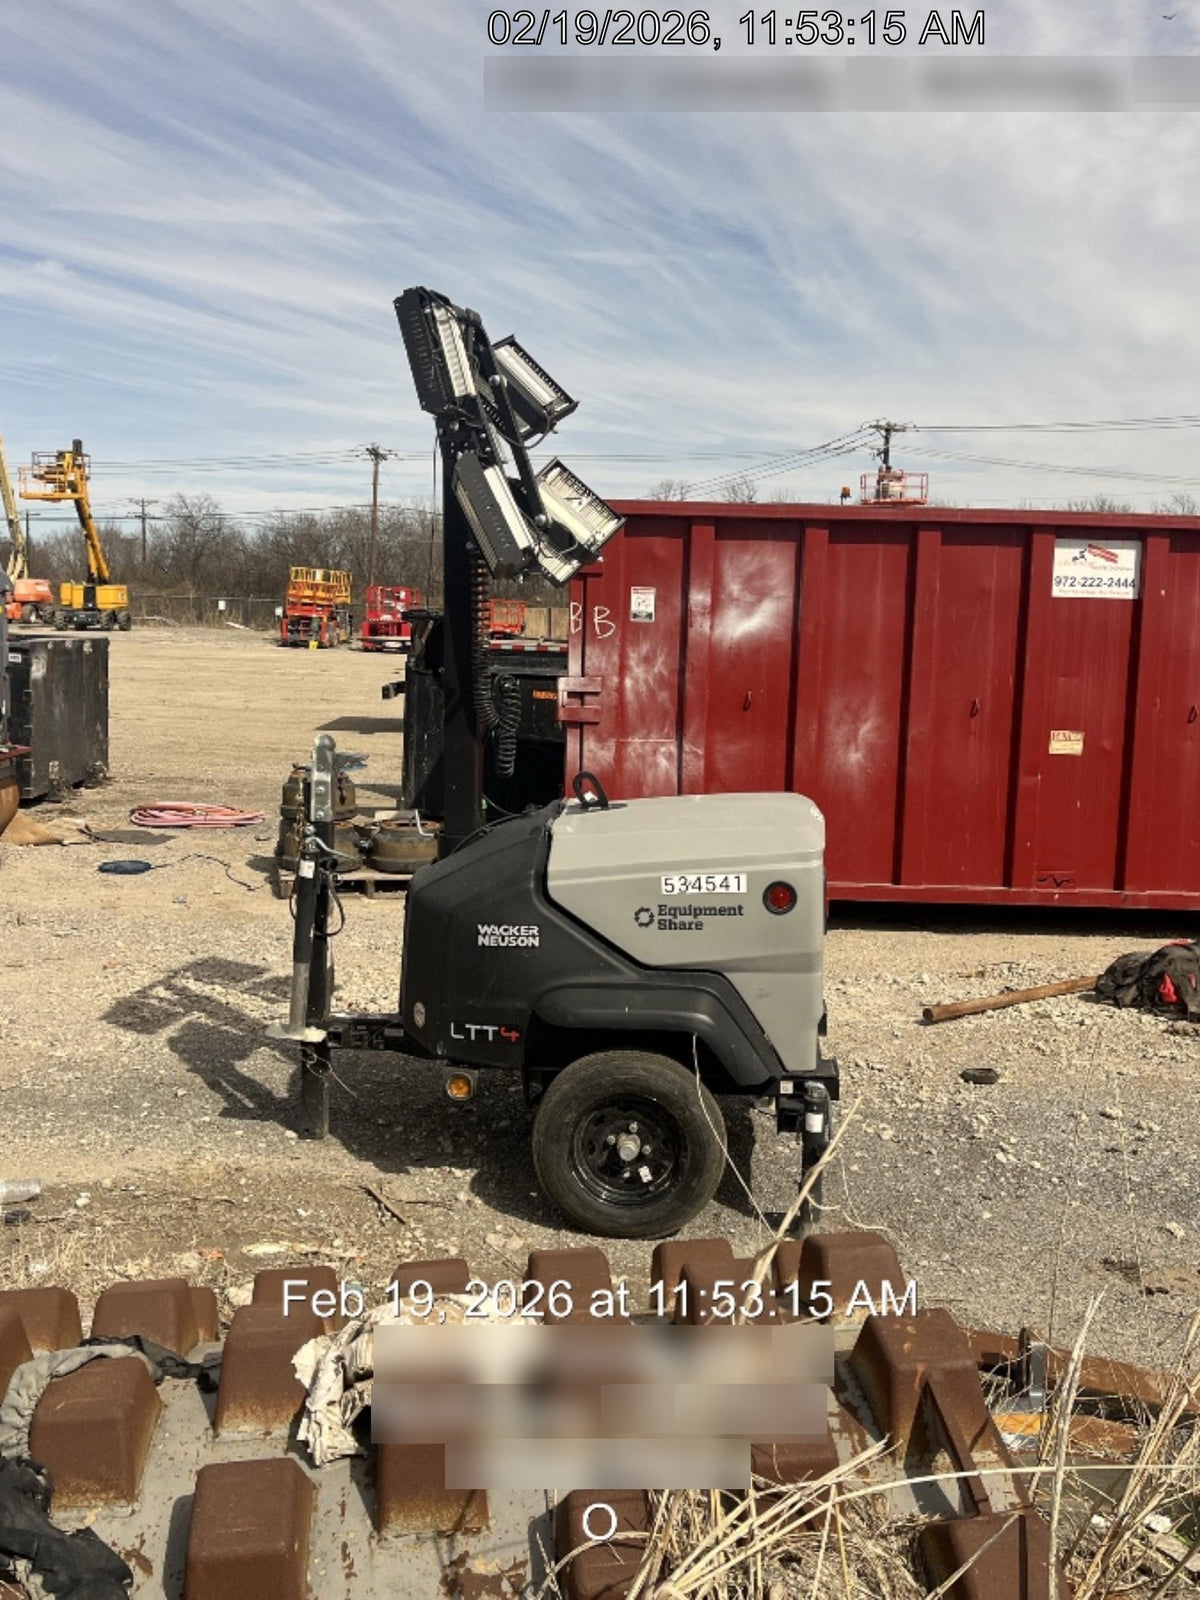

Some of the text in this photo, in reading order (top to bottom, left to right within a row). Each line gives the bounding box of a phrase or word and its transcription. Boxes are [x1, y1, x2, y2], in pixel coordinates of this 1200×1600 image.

[1054, 576, 1136, 589] 972-222-2444
[593, 605, 616, 639] B
[663, 875, 743, 894] 534541
[657, 904, 744, 919] Equipment
[477, 924, 540, 936] WACKER
[657, 919, 704, 931] Share
[477, 934, 540, 948] NEUSON
[450, 1022, 520, 1043] LTT4
